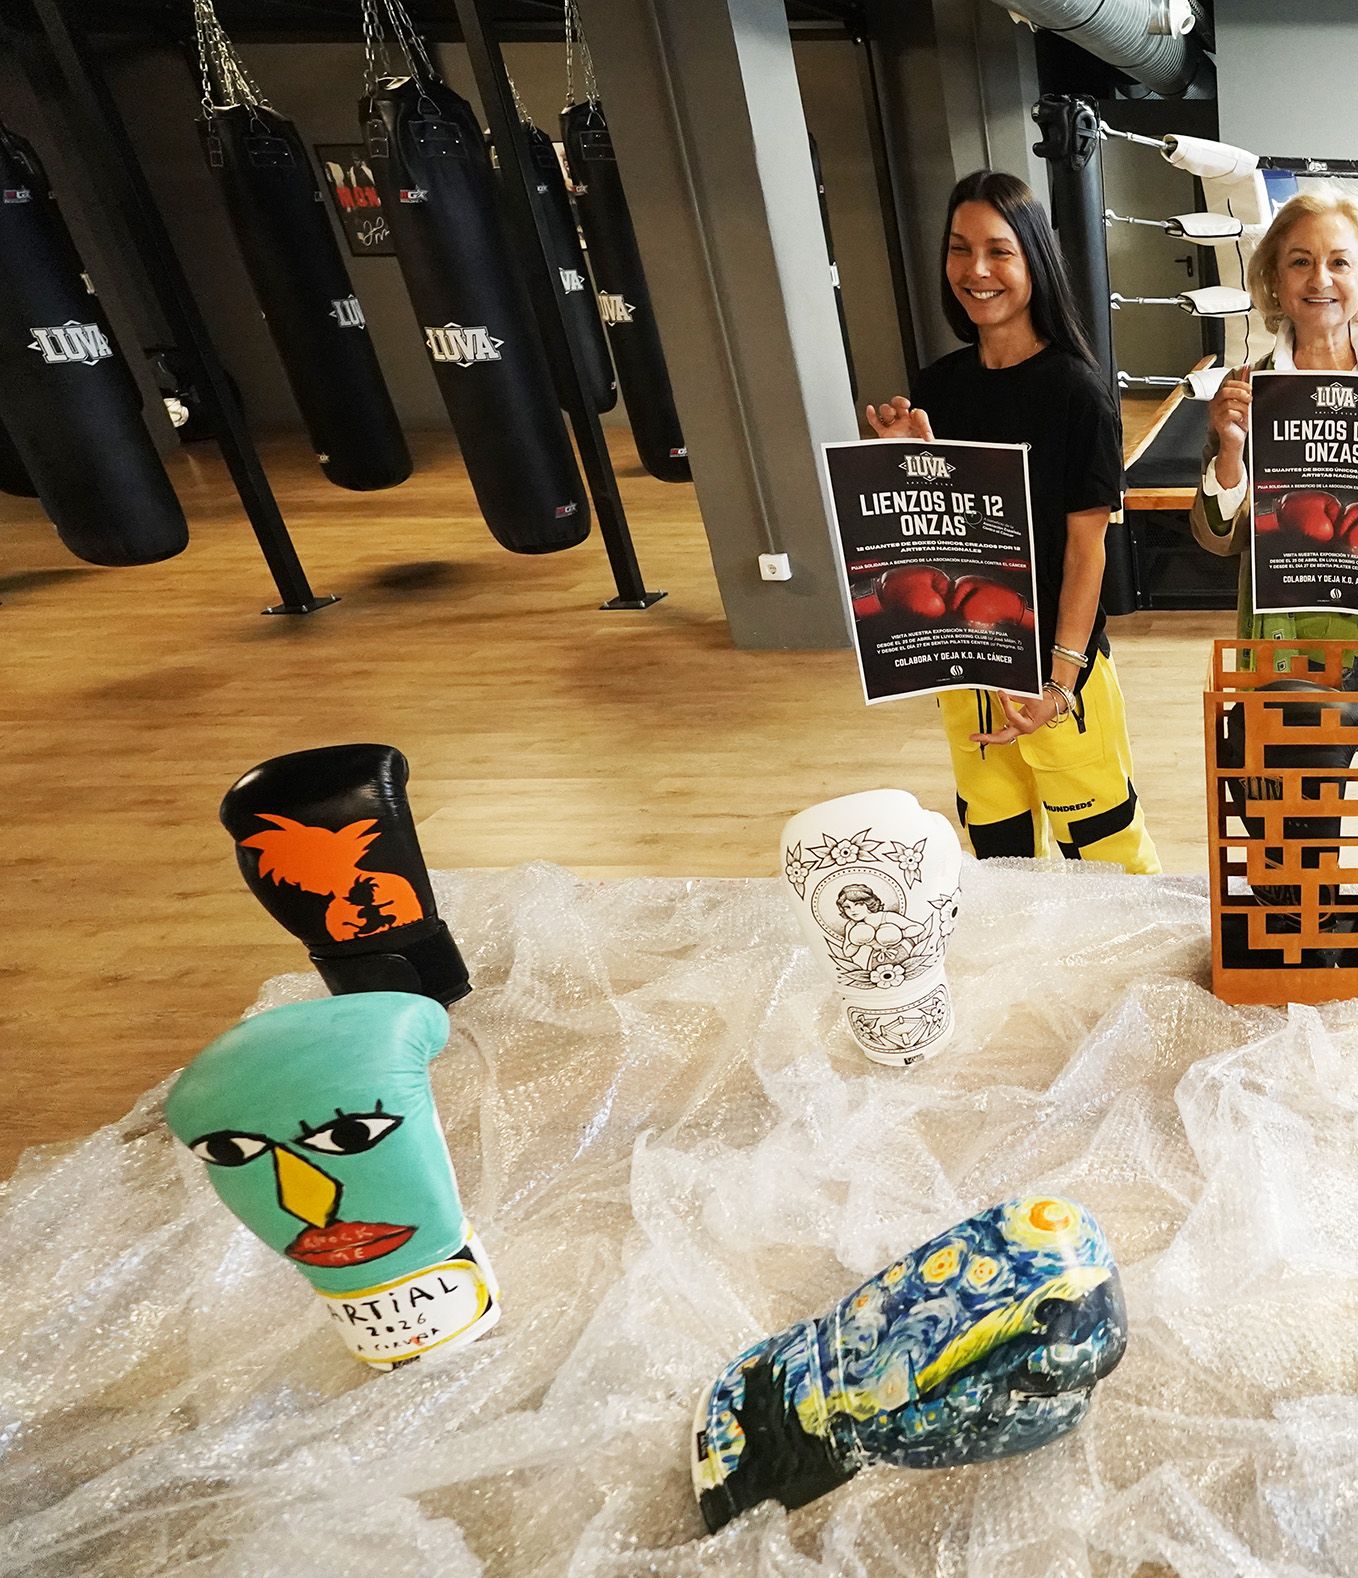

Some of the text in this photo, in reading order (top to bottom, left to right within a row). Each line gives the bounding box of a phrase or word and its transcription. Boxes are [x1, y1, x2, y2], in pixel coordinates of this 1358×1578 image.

[29, 322, 114, 364] LUVA
[424, 325, 502, 363] LUVA
[1316, 386, 1357, 408] LUVA
[1273, 420, 1348, 442] LIENZOS
[904, 454, 951, 478] LUVA
[859, 490, 1004, 518] LIENZOS DE 12
[900, 514, 967, 537] ONZAS
[1283, 575, 1316, 583] COLABORA
[894, 654, 932, 668] COLABORA
[940, 651, 960, 660] DEJA
[977, 652, 986, 660] AL
[987, 652, 1012, 664] CÁNCER
